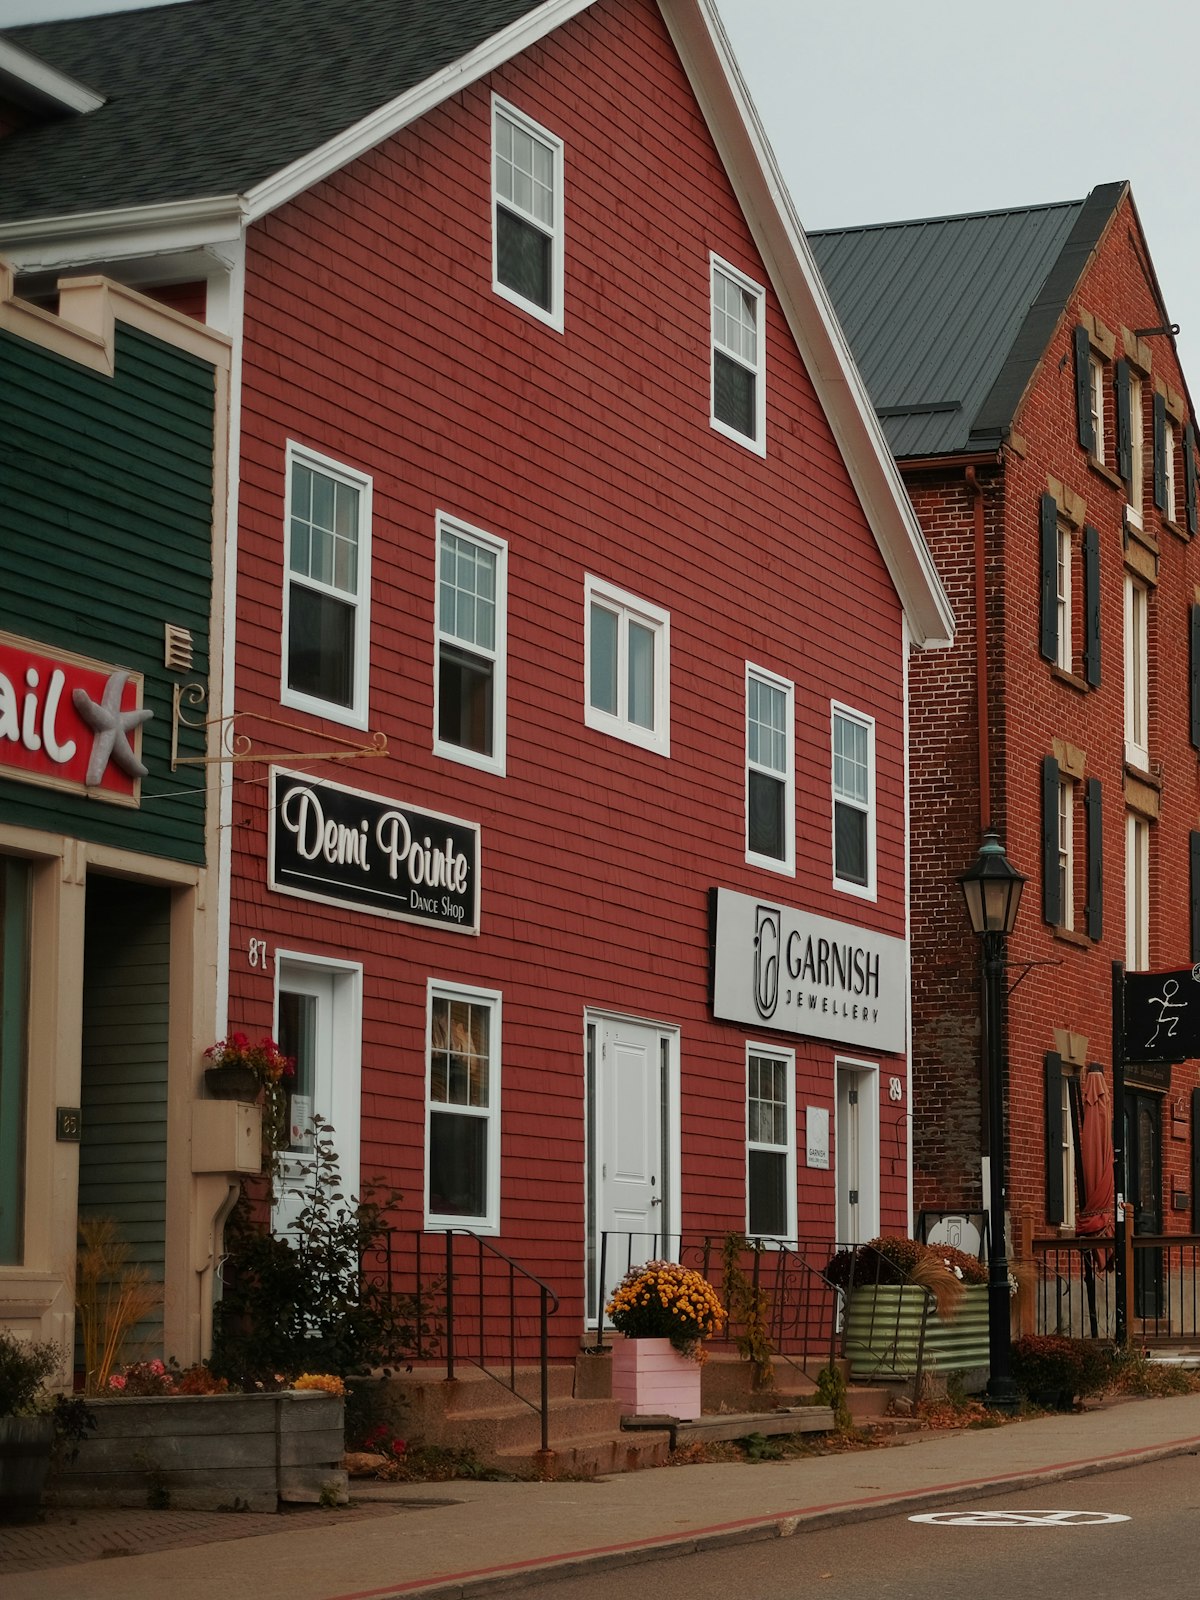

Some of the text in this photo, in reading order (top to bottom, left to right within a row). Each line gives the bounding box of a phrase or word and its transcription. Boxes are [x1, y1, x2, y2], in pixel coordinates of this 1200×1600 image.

[281, 786, 467, 894] Demi Pointe
[249, 937, 267, 969] 87
[787, 930, 879, 998] GARNISH
[786, 989, 878, 1023] JEWELLERY
[889, 1077, 902, 1101] 89
